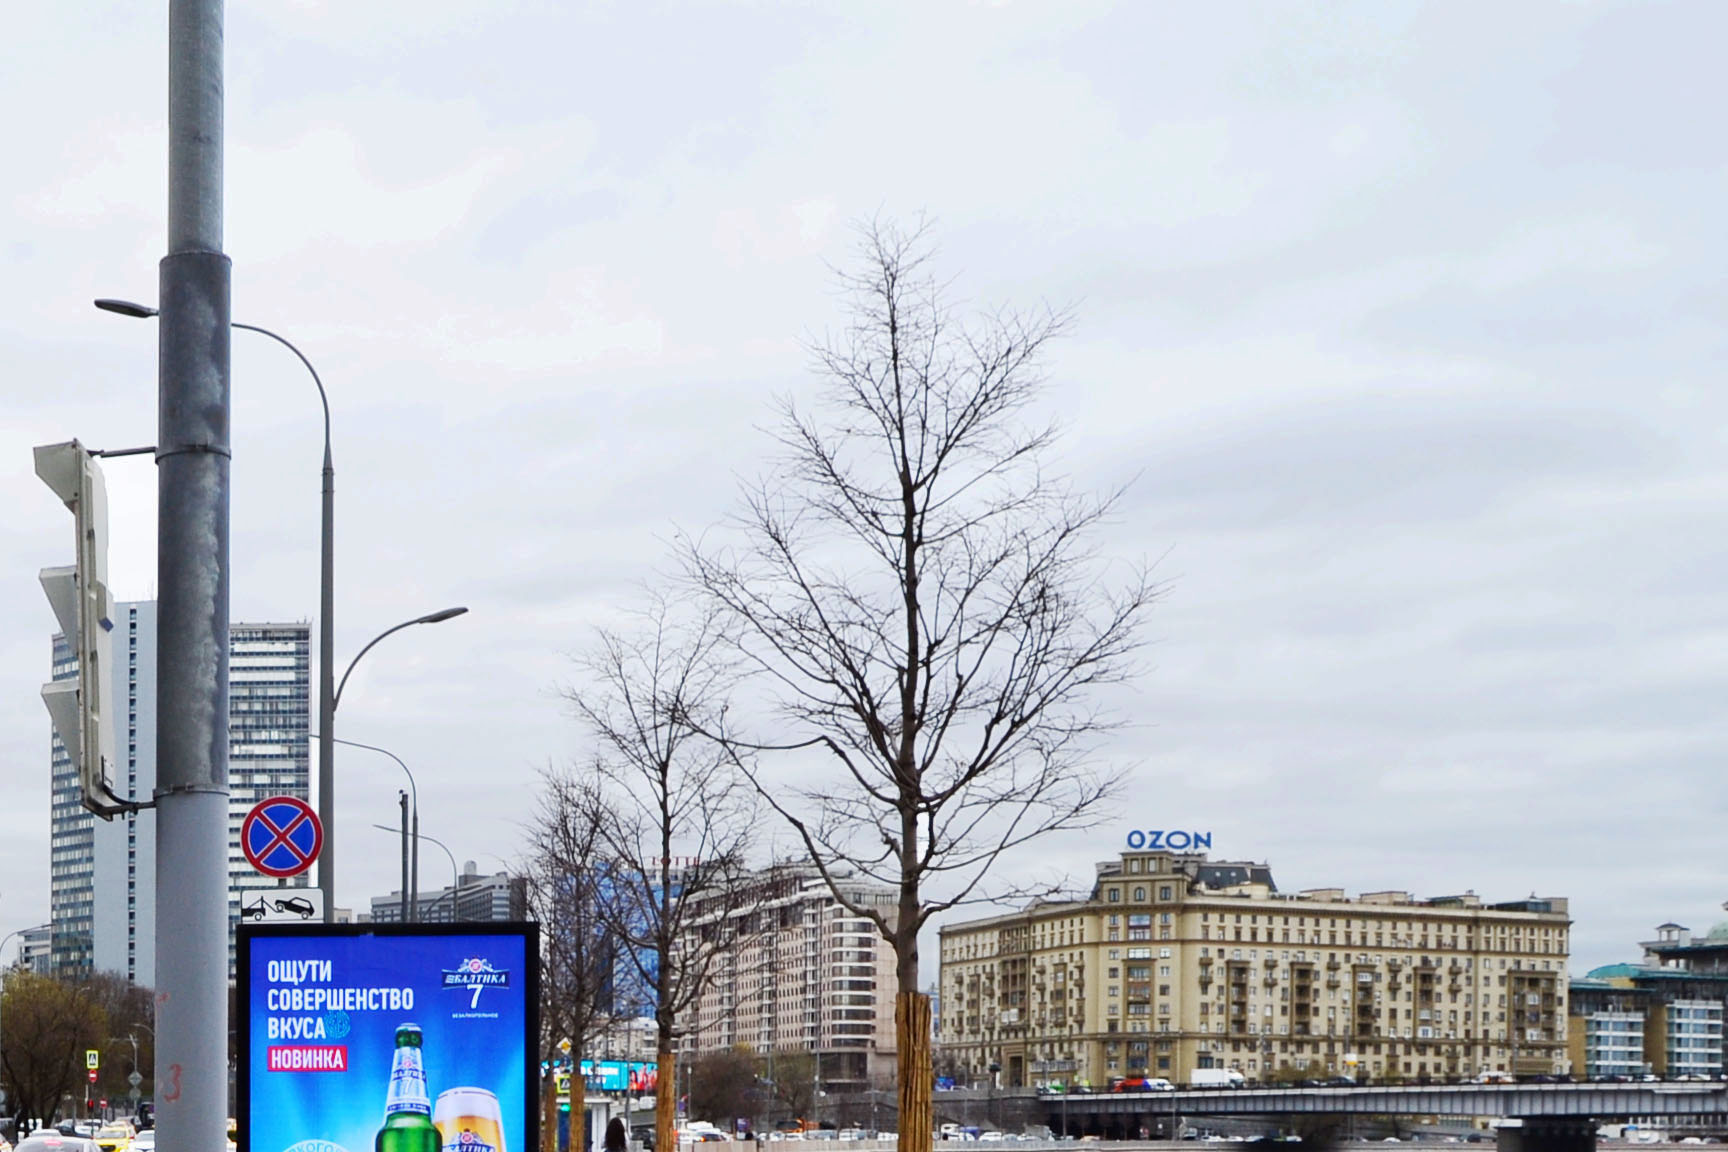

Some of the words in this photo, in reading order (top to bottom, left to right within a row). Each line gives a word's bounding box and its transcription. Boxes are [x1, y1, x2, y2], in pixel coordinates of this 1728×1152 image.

[1127, 830, 1211, 849] OZON
[267, 960, 332, 986] ОЩУТИ
[267, 988, 414, 1011] СОВЕРШЕНСТВО
[467, 984, 484, 1009] 7
[267, 1017, 327, 1039] ВКУСА
[272, 1049, 344, 1069] НОВИНКА
